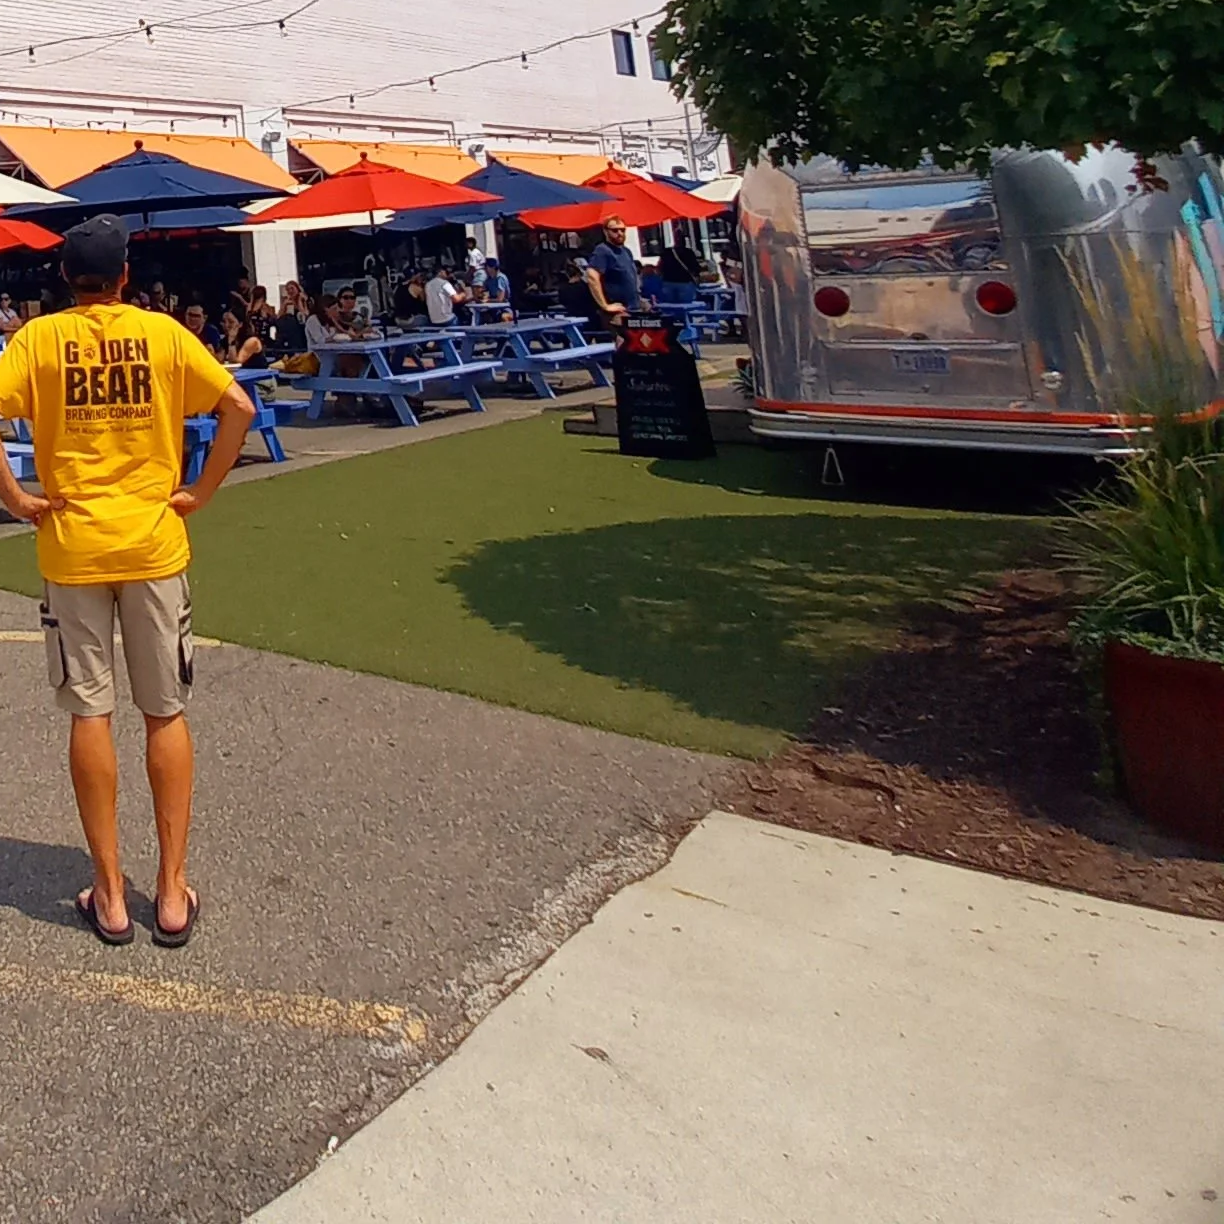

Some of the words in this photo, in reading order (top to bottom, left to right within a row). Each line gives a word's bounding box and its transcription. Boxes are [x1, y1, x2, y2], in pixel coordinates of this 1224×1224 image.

[64, 338, 149, 365] GLDEN
[65, 364, 153, 406] BEAR
[65, 407, 107, 421] BREWING
[109, 406, 153, 419] COMPANY
